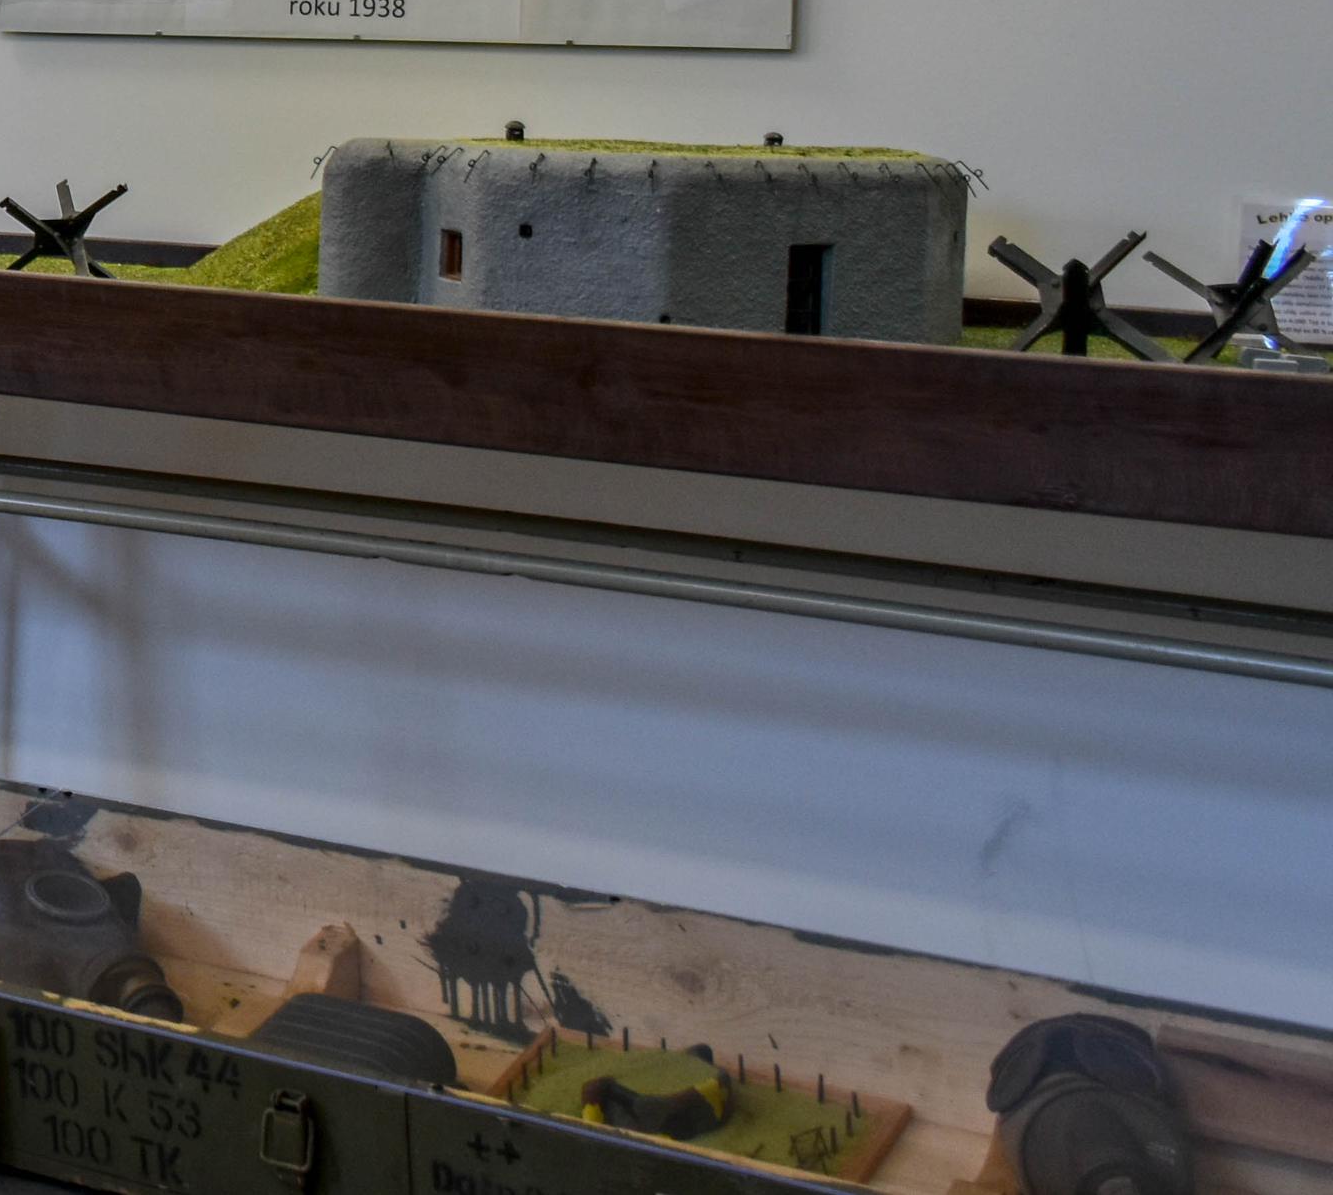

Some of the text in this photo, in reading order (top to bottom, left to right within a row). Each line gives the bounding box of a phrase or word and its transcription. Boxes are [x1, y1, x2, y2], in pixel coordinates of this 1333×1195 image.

[8, 1008, 76, 1059] 100
[185, 1051, 244, 1100] 44
[10, 1056, 203, 1139] 100 K 53
[43, 1115, 185, 1186] 100 TK
